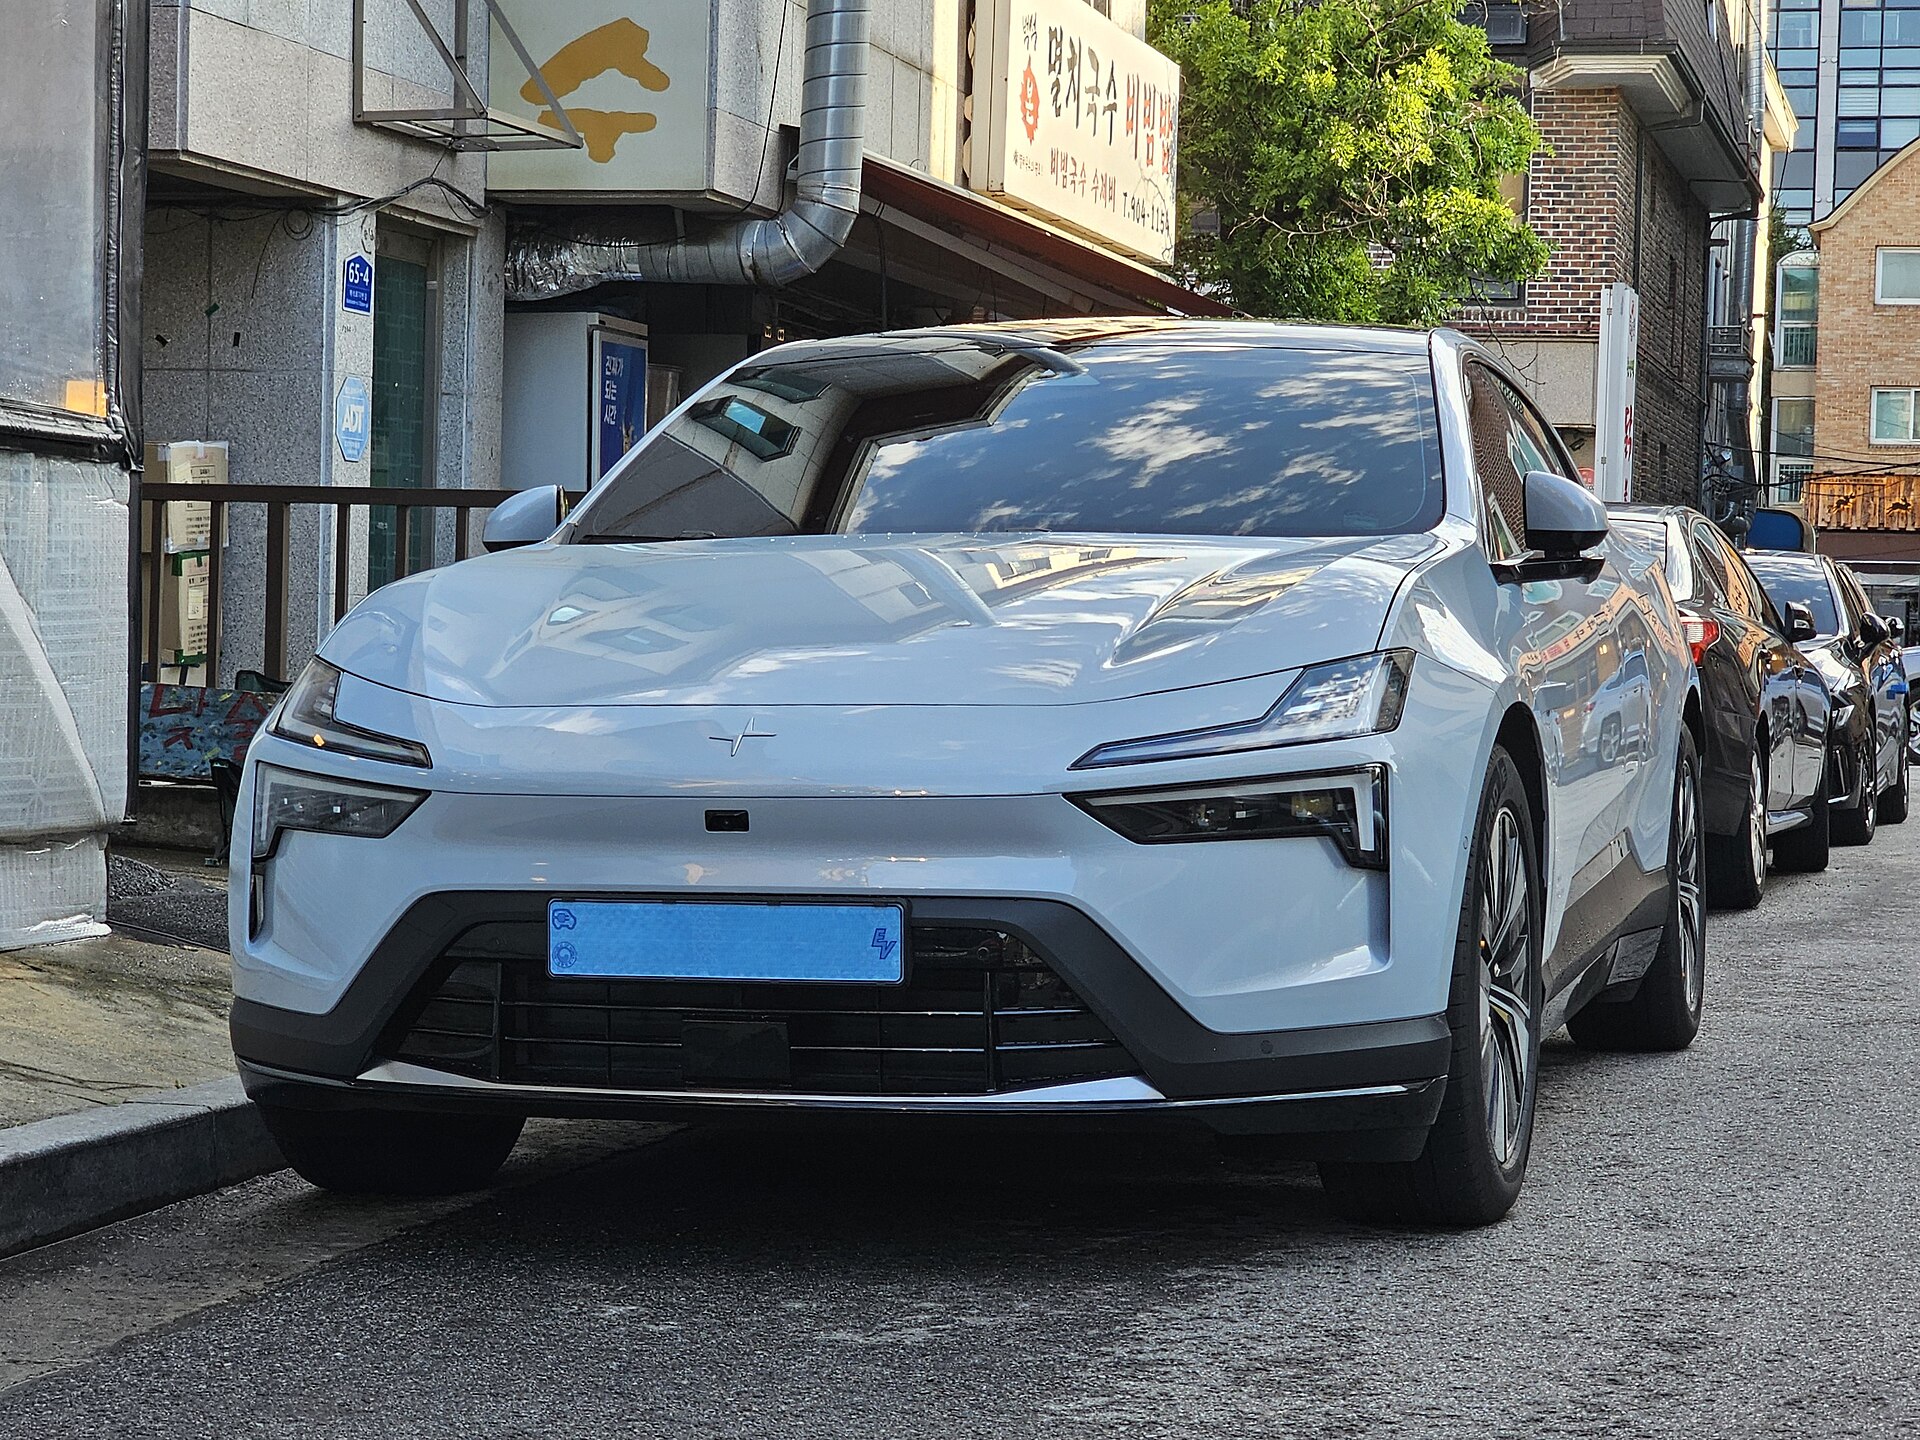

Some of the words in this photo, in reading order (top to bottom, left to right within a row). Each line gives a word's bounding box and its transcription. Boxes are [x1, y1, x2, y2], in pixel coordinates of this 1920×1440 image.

[1048, 25, 1118, 146] 멸치국수
[1126, 72, 1173, 176] 비빔밥
[1050, 147, 1087, 198] 비빔국수
[1091, 168, 1116, 213] 수제비
[348, 262, 369, 286] 65-4
[342, 404, 365, 433] ADT
[603, 404, 617, 425] 시간
[871, 928, 897, 960] EV
